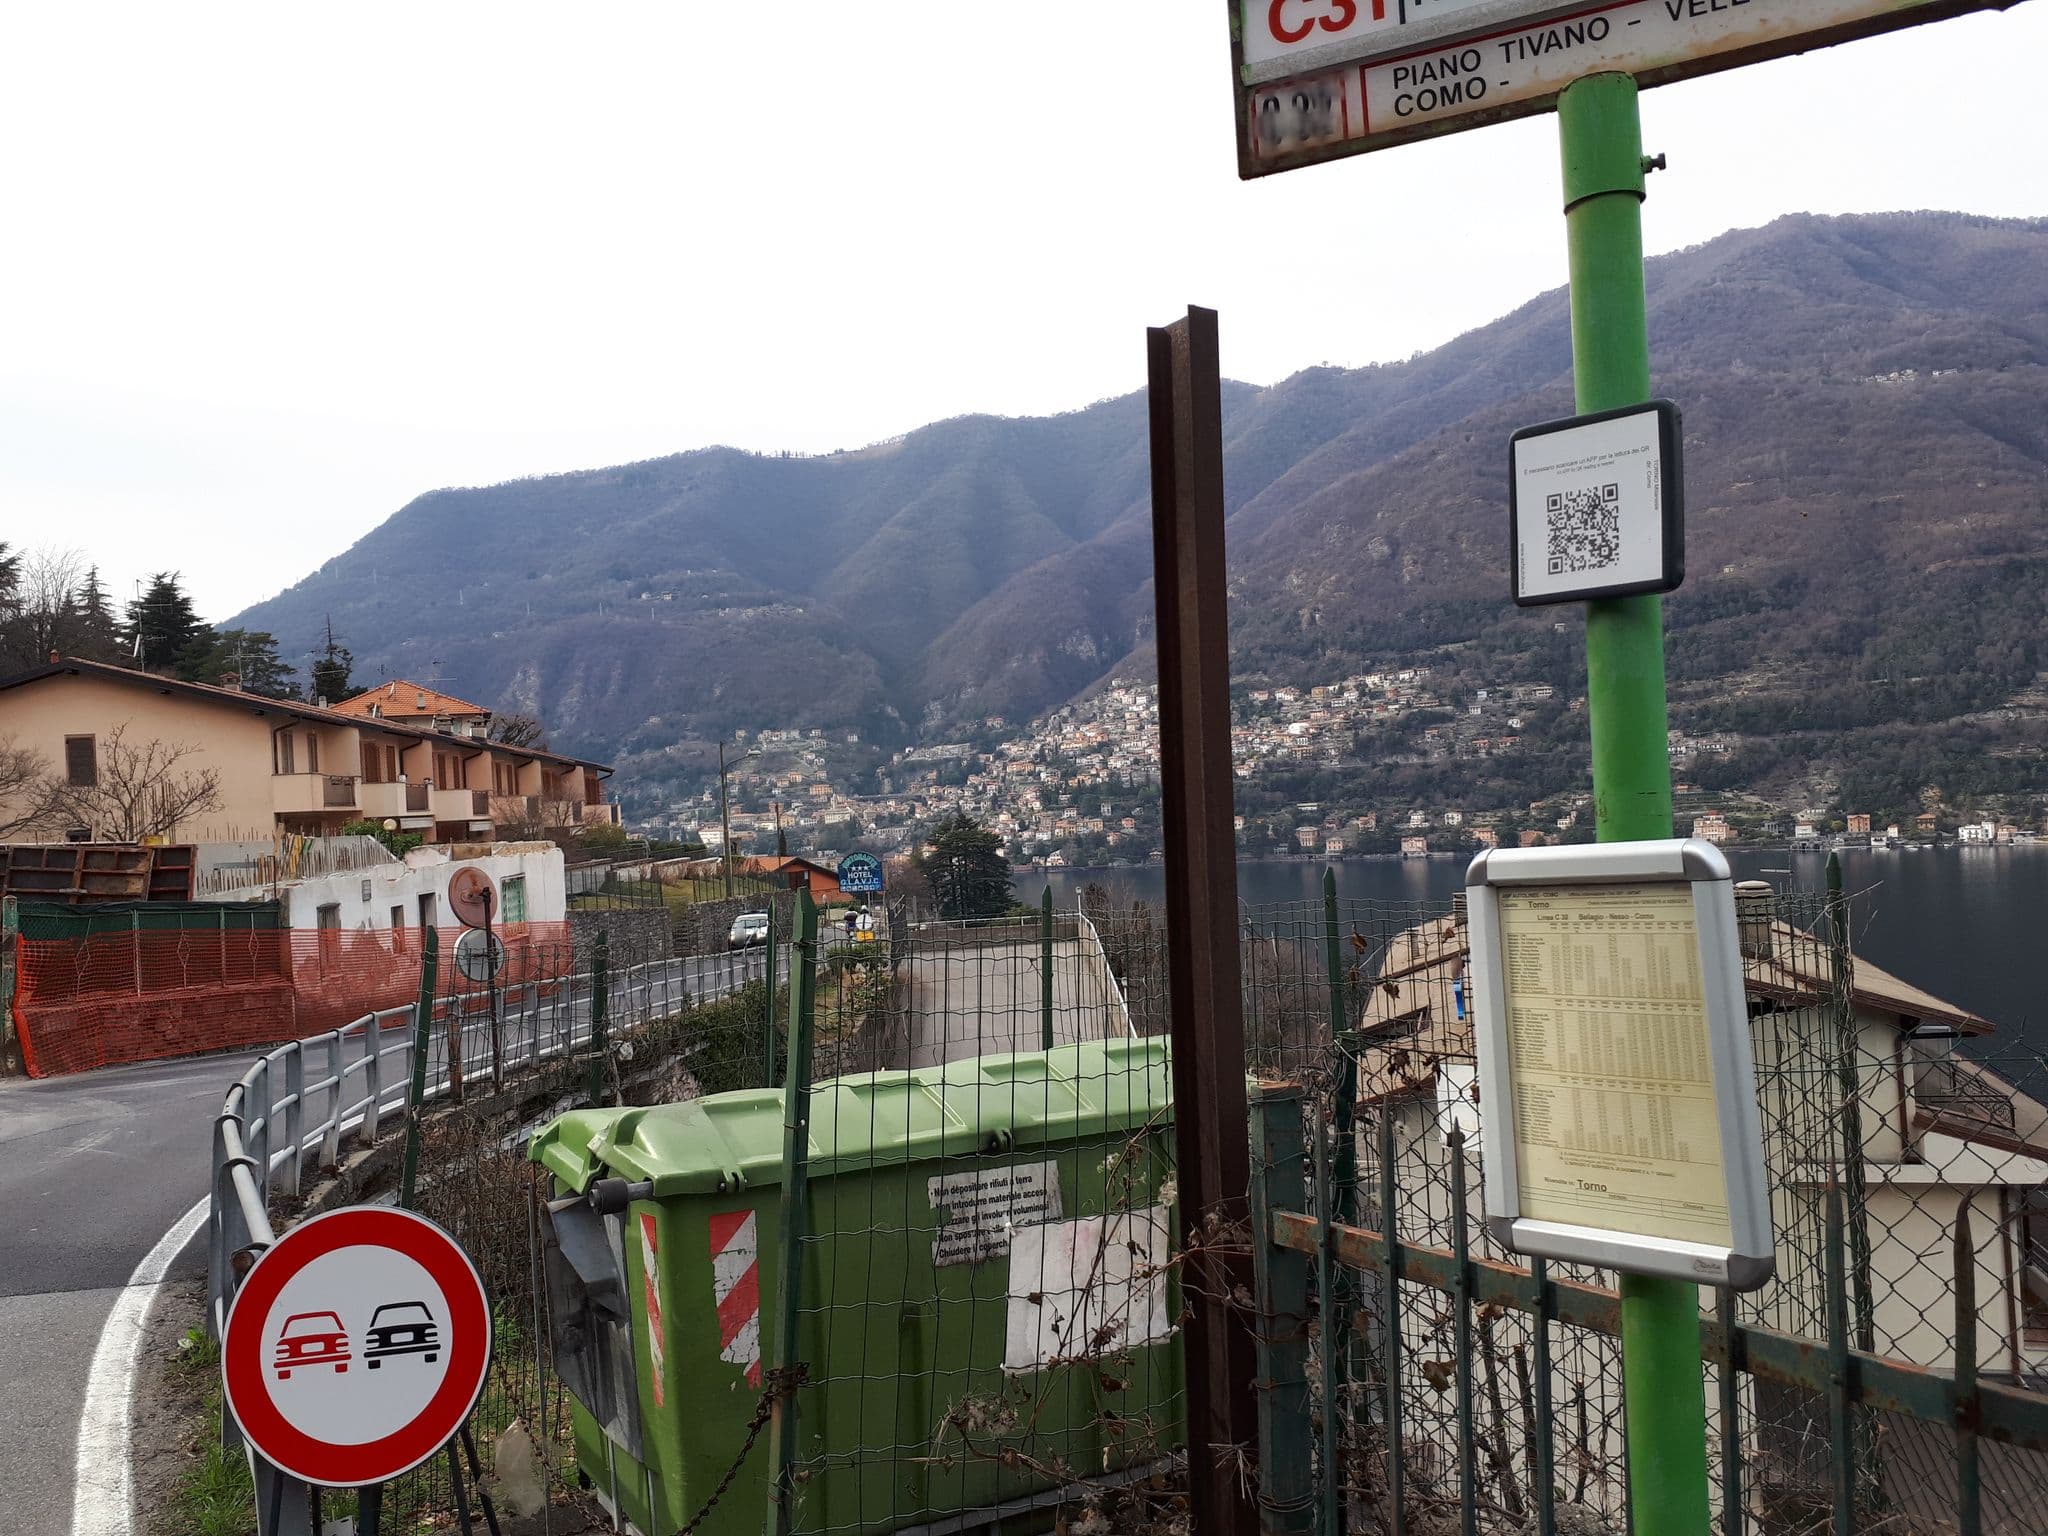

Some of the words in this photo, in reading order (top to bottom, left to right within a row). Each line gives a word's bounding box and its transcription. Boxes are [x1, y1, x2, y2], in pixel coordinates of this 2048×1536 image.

[1393, 49, 1482, 89] PIANO
[1498, 16, 1611, 64] TIVANO
[1394, 76, 1487, 117] COMO
[847, 871, 873, 879] HOTEL
[1528, 901, 1550, 909] Torno
[990, 1179, 1008, 1188] rifiuti
[1015, 1175, 1033, 1184] terra
[1576, 1179, 1608, 1193] Torno
[939, 1247, 971, 1259] Chiudere
